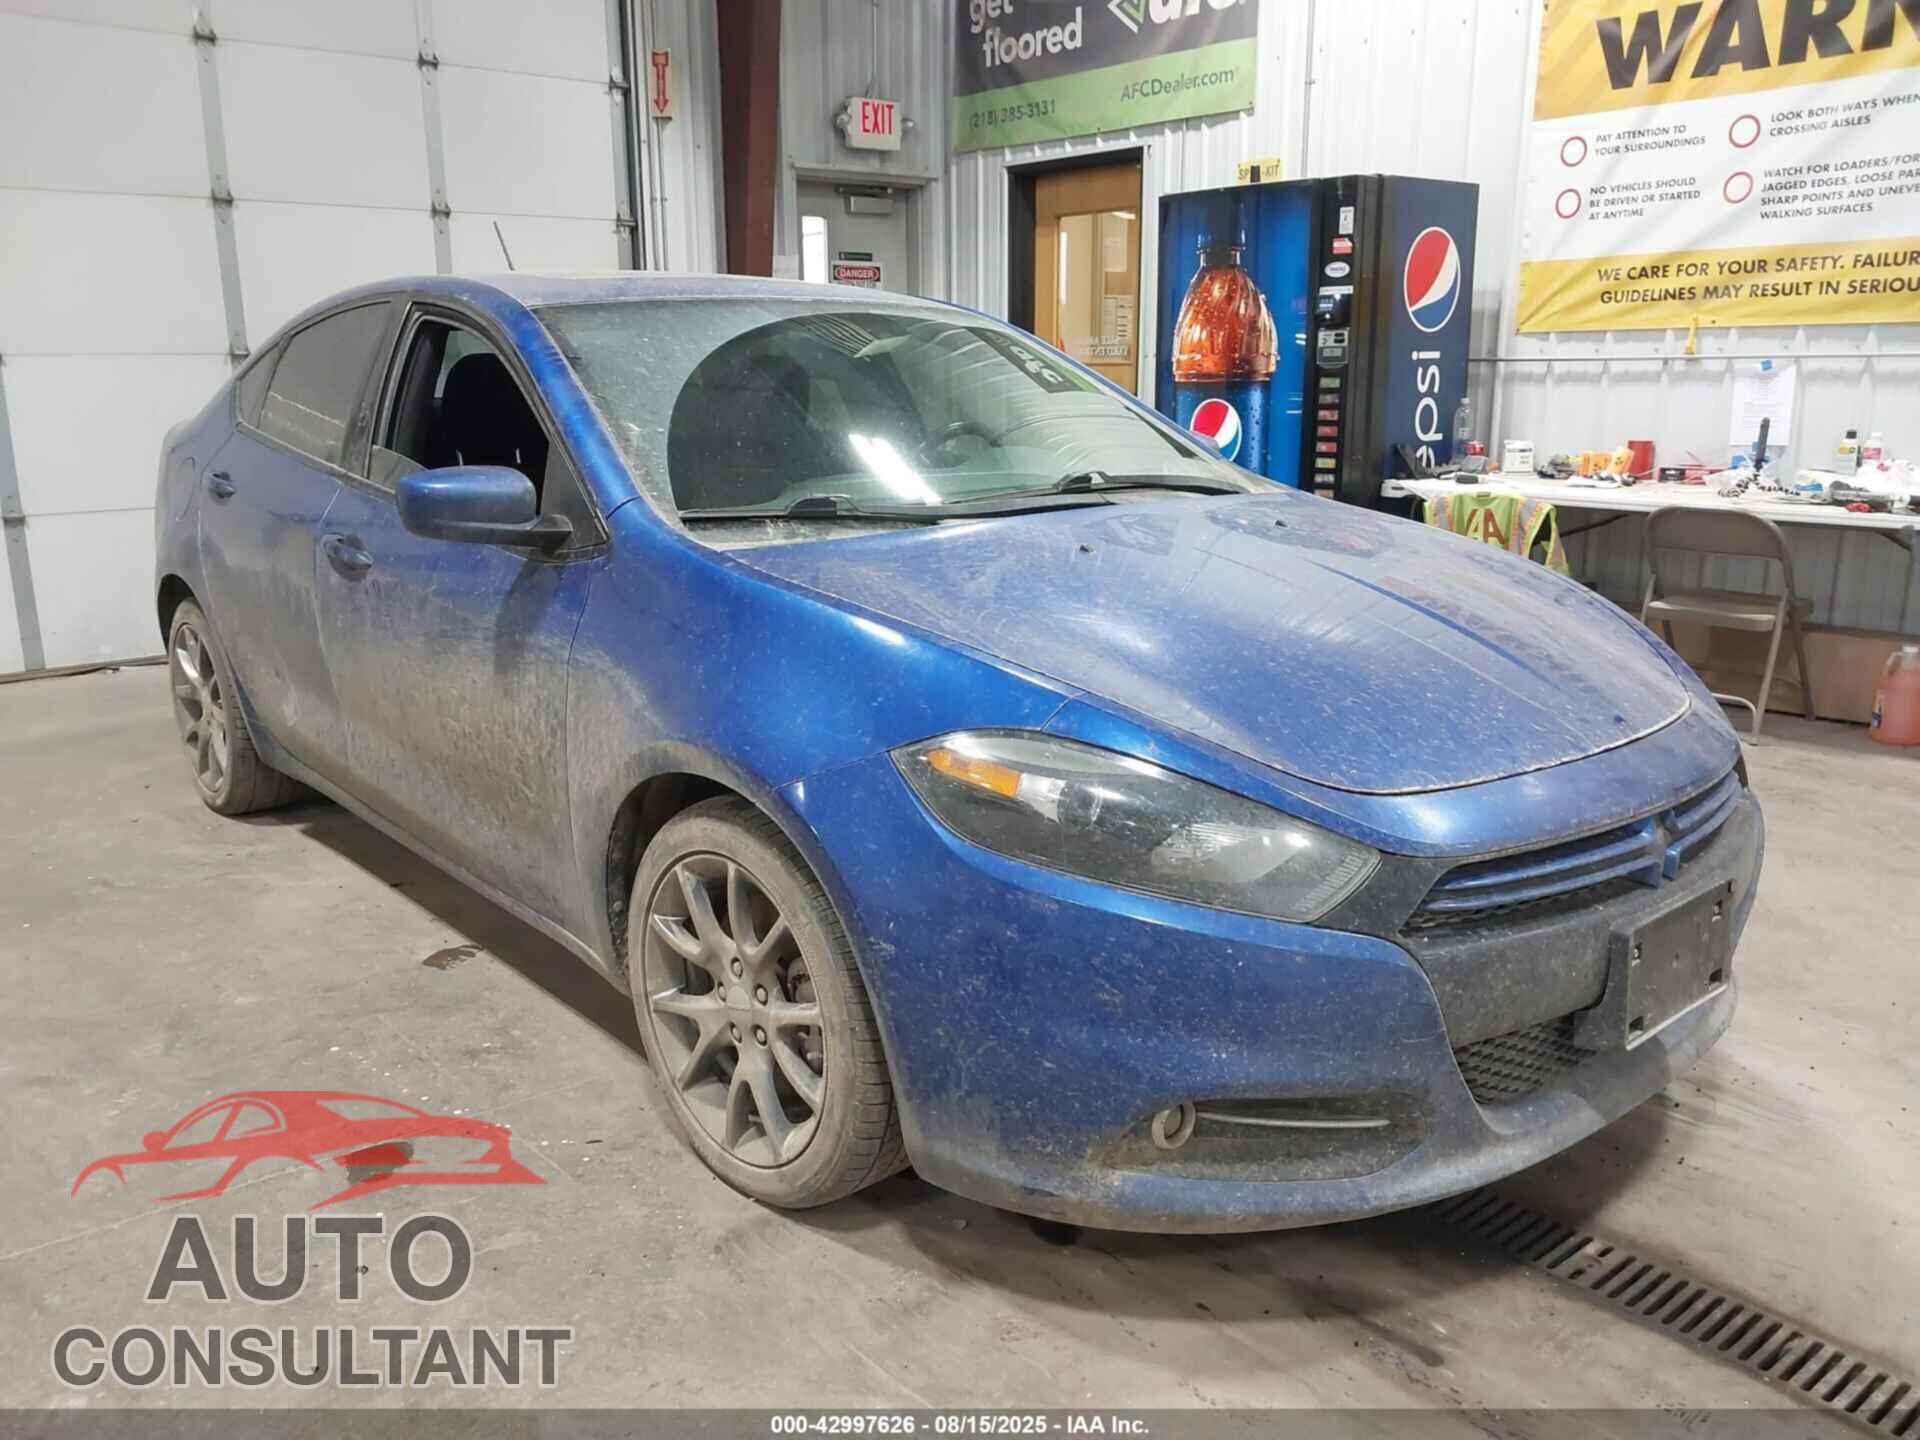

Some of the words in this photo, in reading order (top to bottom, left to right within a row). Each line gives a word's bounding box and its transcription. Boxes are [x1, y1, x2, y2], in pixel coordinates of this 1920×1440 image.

[983, 6, 1082, 68] floored
[1120, 70, 1234, 102] AFCDealer.com
[862, 101, 894, 135] EXIT
[1771, 111, 1803, 123] LOOK
[1808, 104, 1839, 118] BOTH
[1843, 99, 1878, 112] WAYS
[1616, 128, 1670, 141] ATTENTION
[1673, 124, 1687, 134] TO
[1770, 121, 1828, 136] CROSSING
[1831, 114, 1871, 128] AISLES
[1595, 145, 1621, 156] YOUR
[1624, 136, 1706, 153] SURROUNDINGS
[1761, 180, 1807, 193] JAGGED
[1855, 171, 1895, 184] LOOSE
[1764, 166, 1802, 178] WATCH
[1807, 164, 1830, 174] FOR
[1590, 185, 1607, 195] NO
[1610, 181, 1653, 193] VEHICLES
[1655, 177, 1696, 189] SHOULD
[1760, 195, 1798, 206] SHARP
[1802, 191, 1843, 203] POINTS
[1847, 187, 1874, 199] AND
[1879, 183, 1920, 196] UNEVE
[1589, 199, 1601, 208] BE
[1604, 196, 1639, 207] DRIVEN
[1641, 194, 1655, 203] OR
[1658, 190, 1701, 202] STARTED
[1588, 212, 1600, 220] AT
[1603, 207, 1644, 219] ANYTIME
[1760, 208, 1812, 219] WALKING
[1816, 202, 1873, 216] SURFACES
[840, 268, 874, 279] DANGER
[1598, 267, 1621, 282] WE
[1627, 265, 1670, 280] CARE
[1676, 262, 1710, 277] FOR
[1717, 259, 1768, 275] YOUR
[1775, 255, 1845, 273] SAFETY.
[1853, 250, 1920, 269] FAILUR
[1601, 286, 1697, 304] GUIDELINES
[1704, 284, 1744, 299] MAY
[1749, 281, 1813, 298] RESULT
[1819, 280, 1841, 295] IN
[1847, 277, 1920, 294] SERIOU
[1412, 350, 1443, 470] epsi
